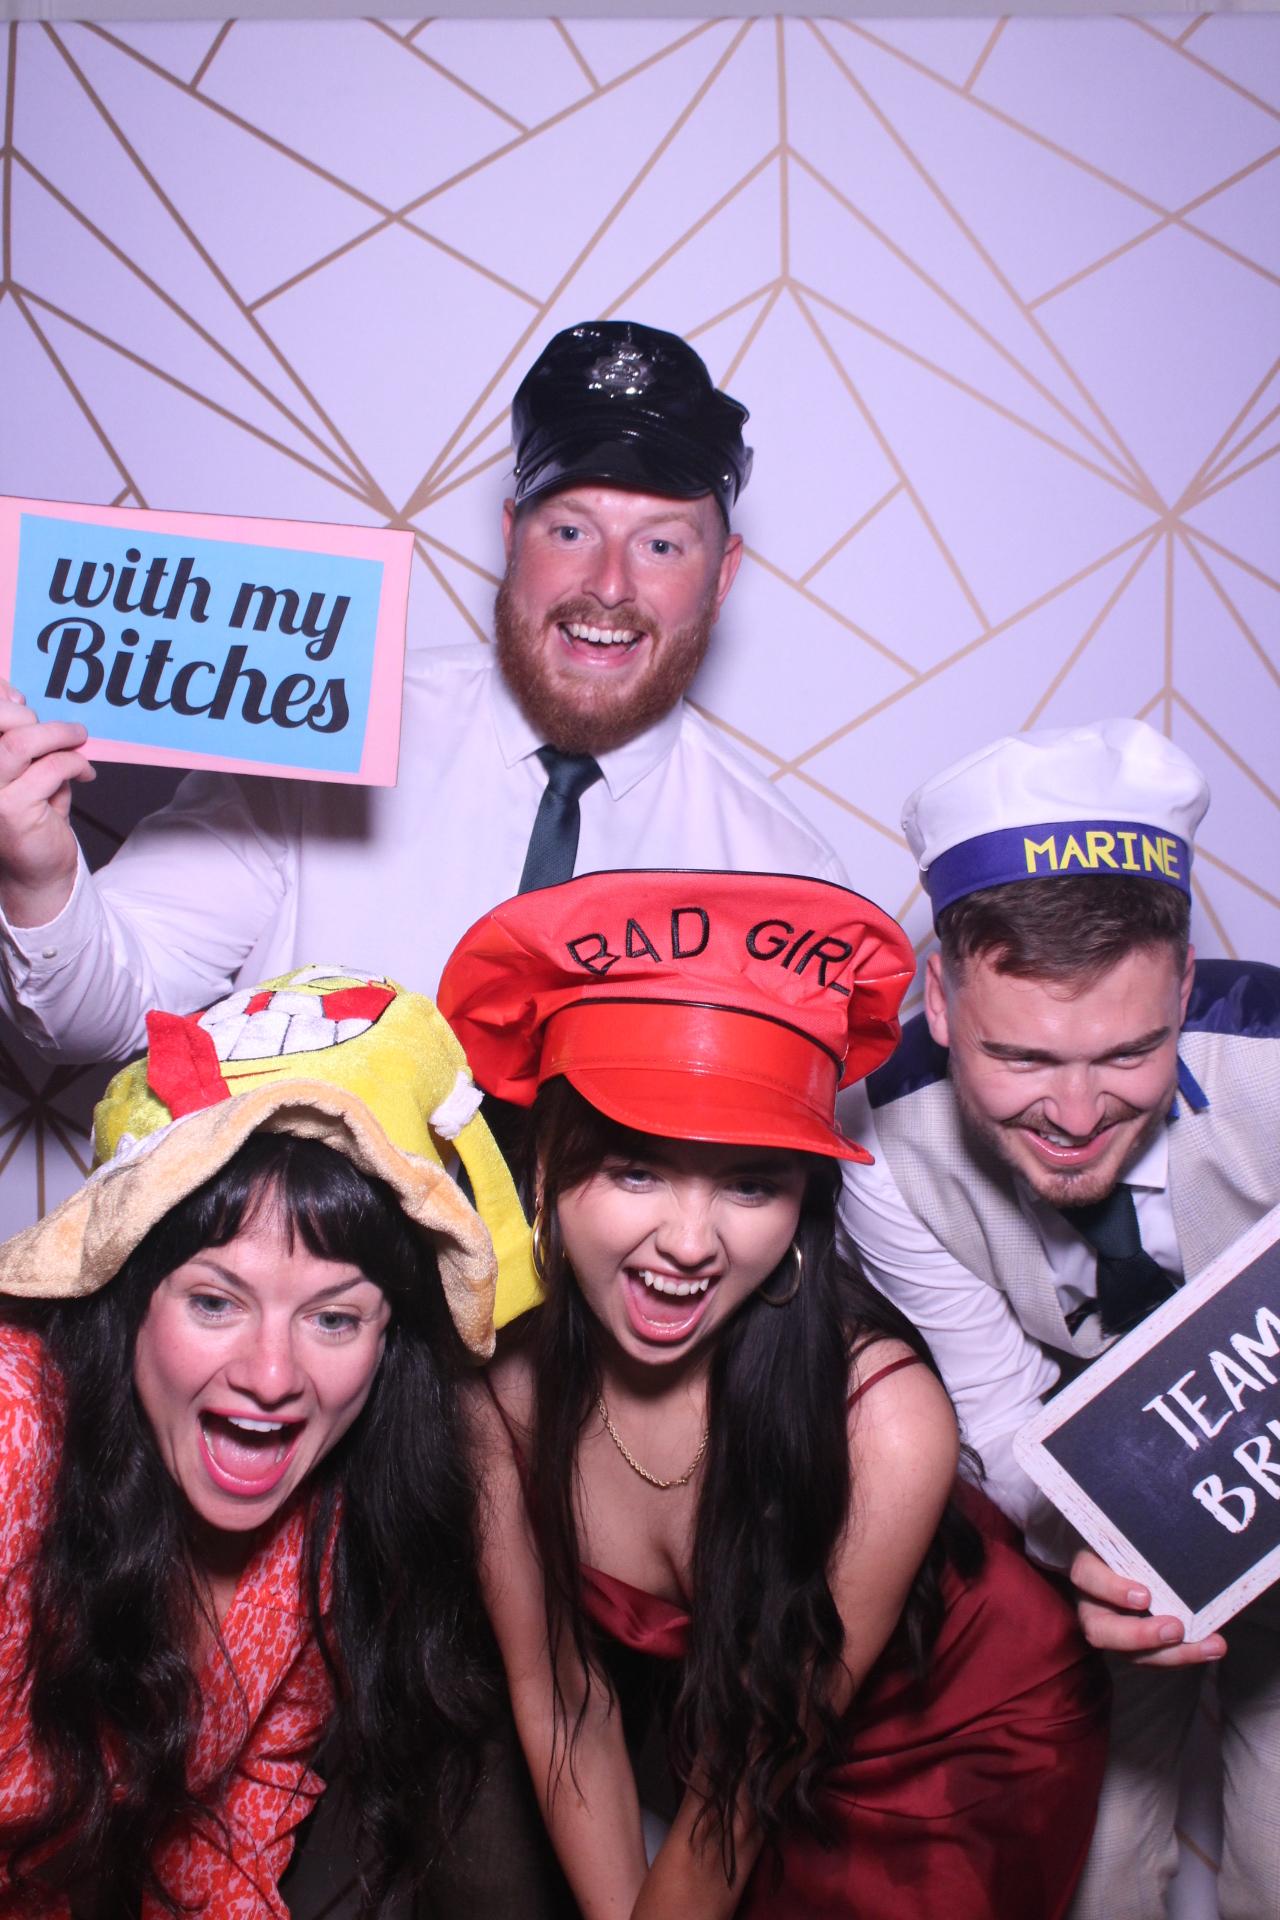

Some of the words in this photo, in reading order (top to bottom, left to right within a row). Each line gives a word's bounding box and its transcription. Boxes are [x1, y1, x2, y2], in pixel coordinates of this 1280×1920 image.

[48, 547, 212, 623] with
[228, 582, 352, 662] my
[36, 616, 350, 734] Bitches
[1023, 830, 1180, 879] MARINE
[565, 906, 710, 976] BAD
[1141, 1306, 1280, 1451] TEAM
[1192, 1419, 1280, 1534] BR
